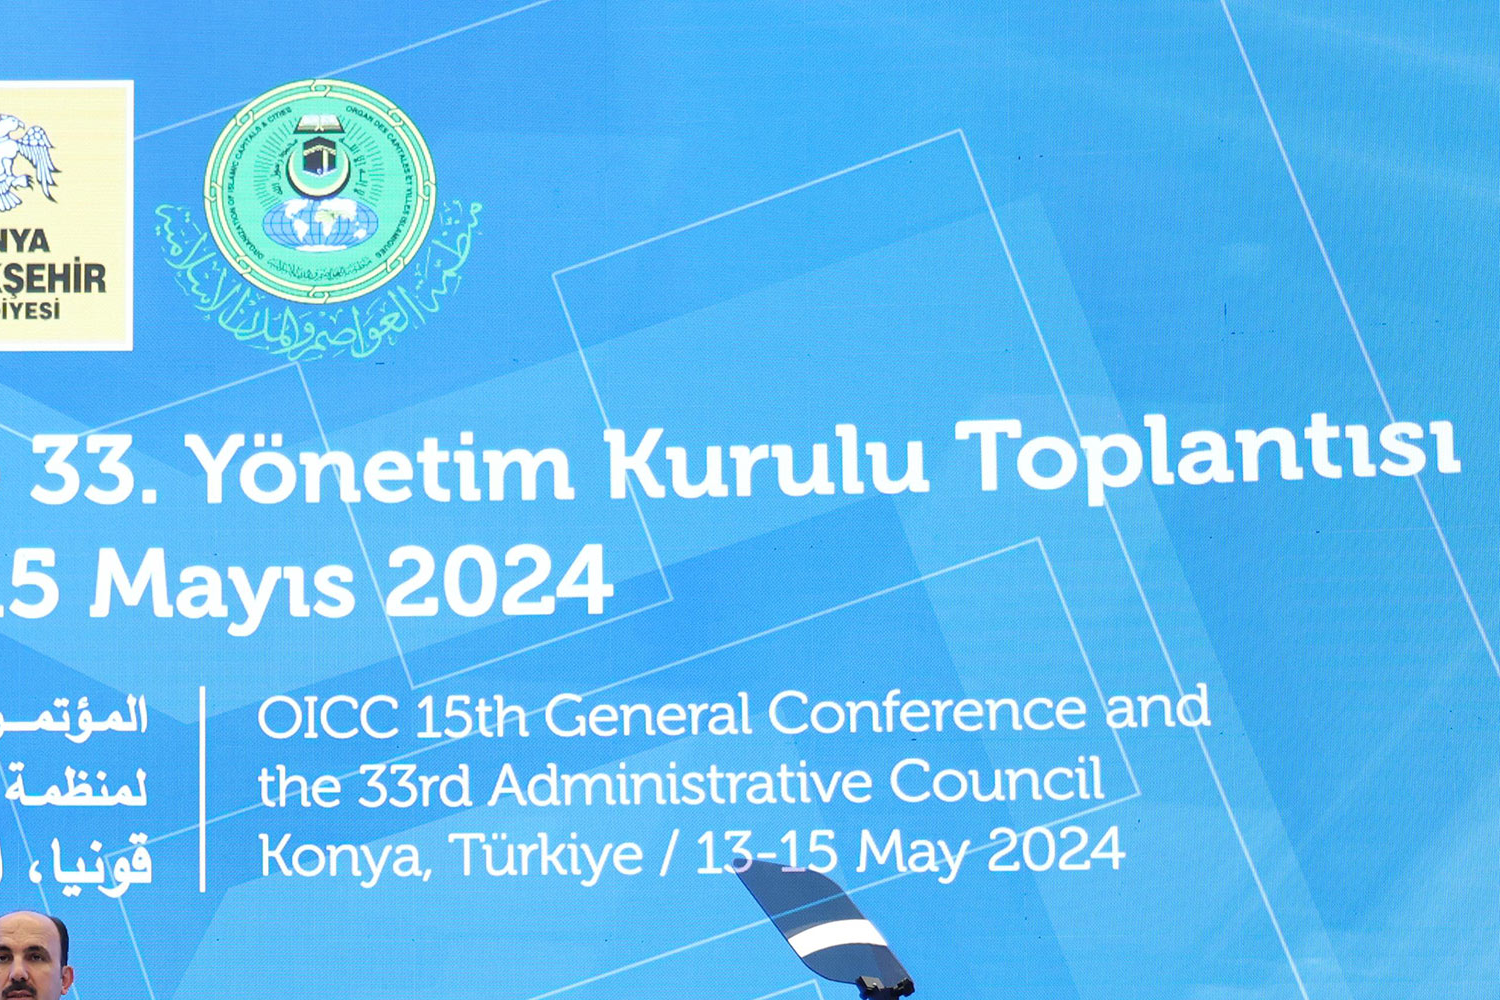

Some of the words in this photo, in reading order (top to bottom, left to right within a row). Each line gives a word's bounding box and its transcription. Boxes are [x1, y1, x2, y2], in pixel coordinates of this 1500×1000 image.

[30, 434, 157, 505] 33.
[184, 431, 575, 504] Yönetim
[603, 424, 930, 499] Kurulu
[955, 413, 1461, 507] Toplantısı
[89, 547, 355, 637] Mayıs
[385, 543, 614, 617] 2024
[258, 695, 399, 739] OICC
[417, 694, 530, 739] 15th
[545, 691, 753, 737] General
[768, 689, 1087, 735] Conference
[1106, 682, 1212, 729] and
[4, 761, 147, 806] لمنظمة
[257, 764, 341, 808] the
[358, 763, 473, 808] 33rd
[487, 760, 873, 807] Administrative
[890, 755, 1105, 803] Council
[258, 833, 432, 889] Konya,
[447, 831, 643, 887] Türkiye
[659, 828, 680, 877] /
[695, 829, 838, 875] 13-15
[856, 828, 971, 883] May
[988, 825, 1127, 872] 2024
